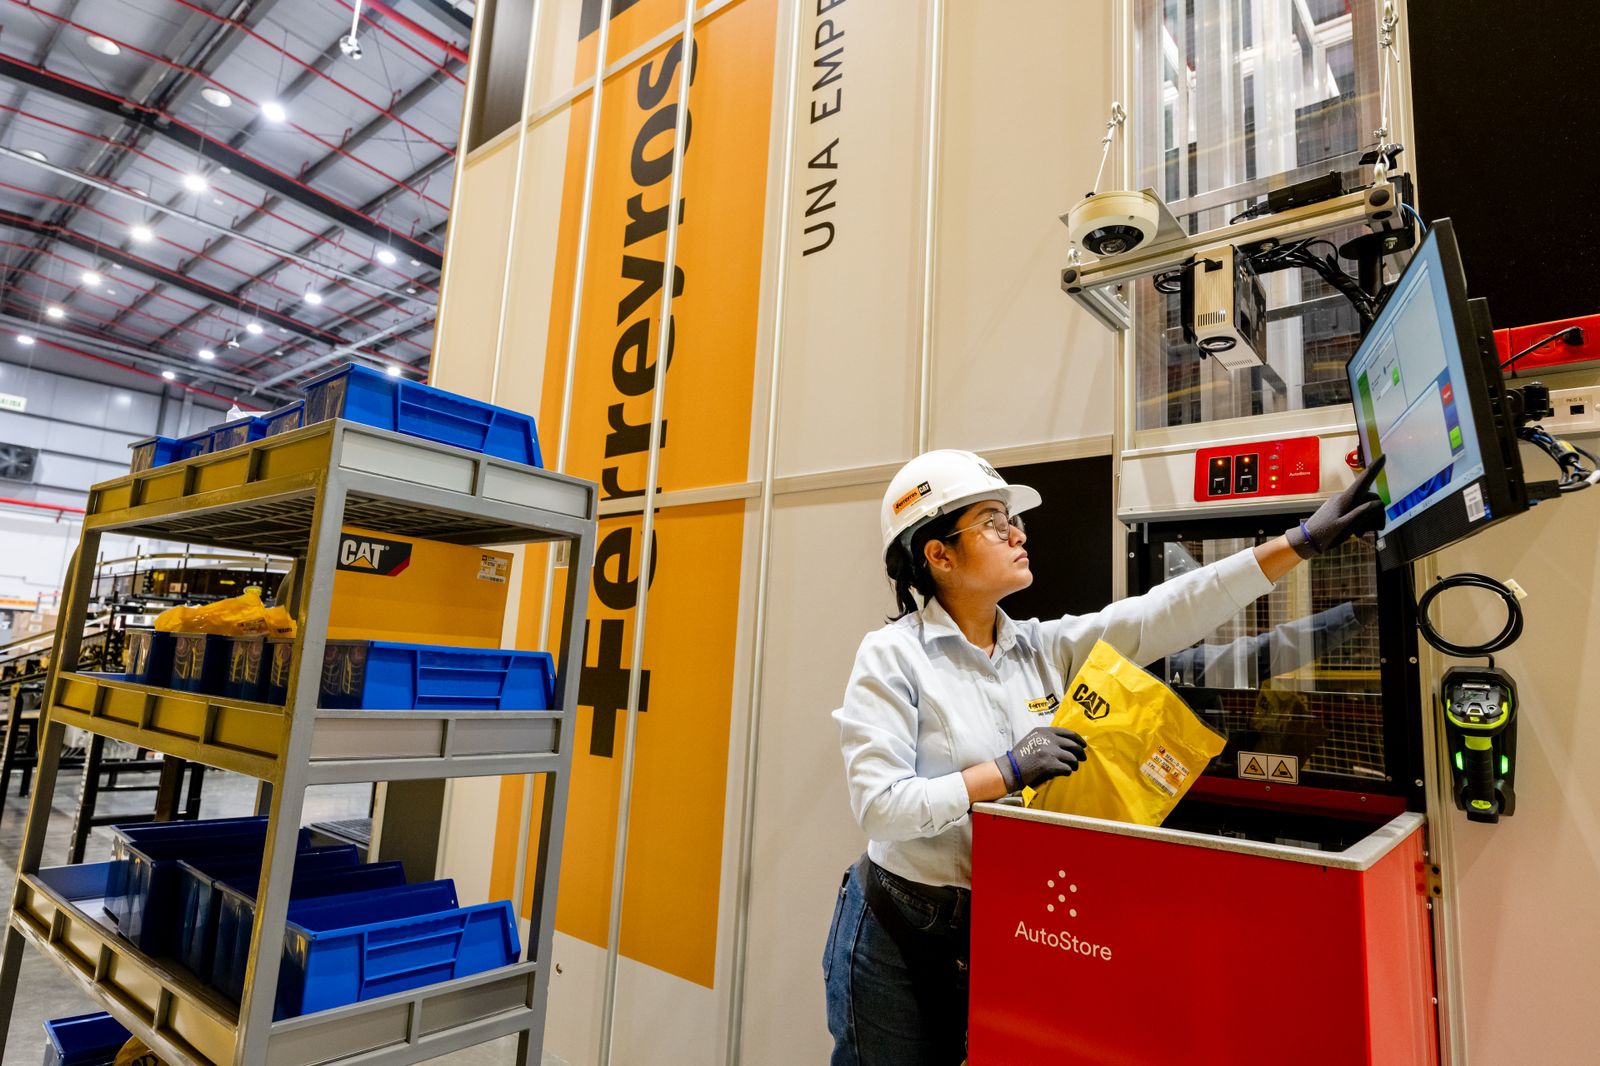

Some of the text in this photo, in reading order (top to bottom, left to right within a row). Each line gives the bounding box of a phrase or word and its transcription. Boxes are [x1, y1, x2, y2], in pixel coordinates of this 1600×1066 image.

[802, 137, 840, 257] UNA
[577, 36, 698, 758] ferreyros
[1072, 683, 1107, 716] CAT
[1015, 920, 1112, 961] AutoStore
